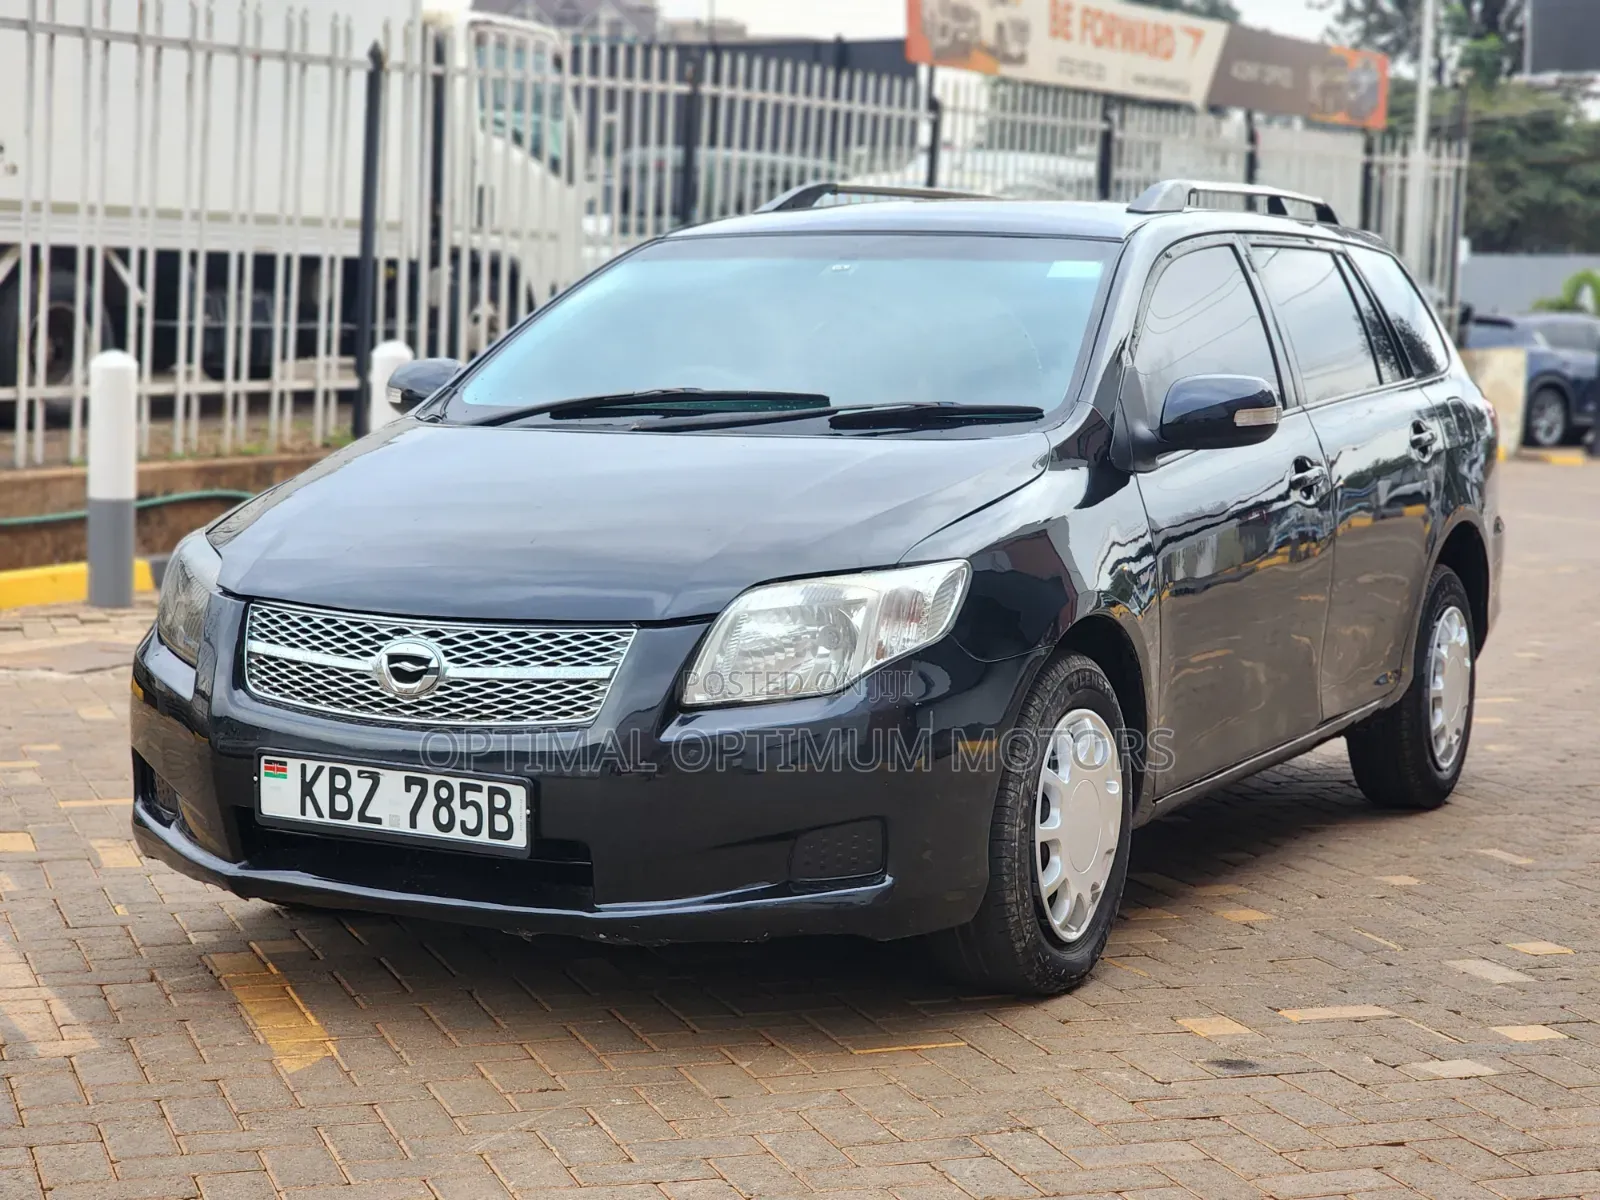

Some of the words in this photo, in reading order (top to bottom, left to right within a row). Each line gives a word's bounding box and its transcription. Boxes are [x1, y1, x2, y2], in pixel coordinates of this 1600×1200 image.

[1047, 0, 1074, 42] BE
[1080, 5, 1177, 61] FORWARD
[300, 762, 383, 825] KBZ
[404, 775, 514, 841] 785B
